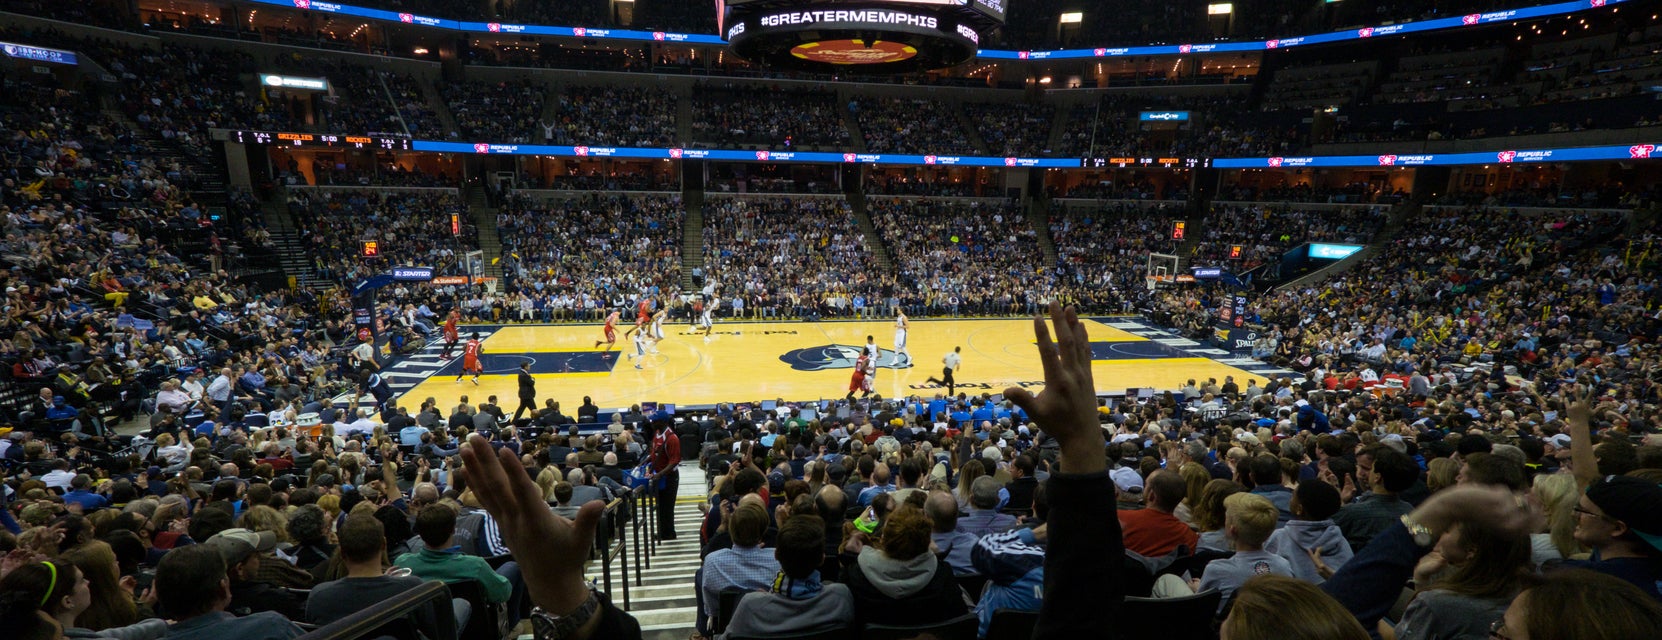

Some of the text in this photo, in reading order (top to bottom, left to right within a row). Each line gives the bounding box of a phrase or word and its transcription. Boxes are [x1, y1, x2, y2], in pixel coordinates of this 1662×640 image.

[761, 10, 938, 29] #GREATERMEMPHIS
[277, 133, 314, 141] GRIZZLIES
[345, 136, 372, 144] ROCKETS
[1173, 228, 1183, 239] 24
[365, 247, 376, 255] 24
